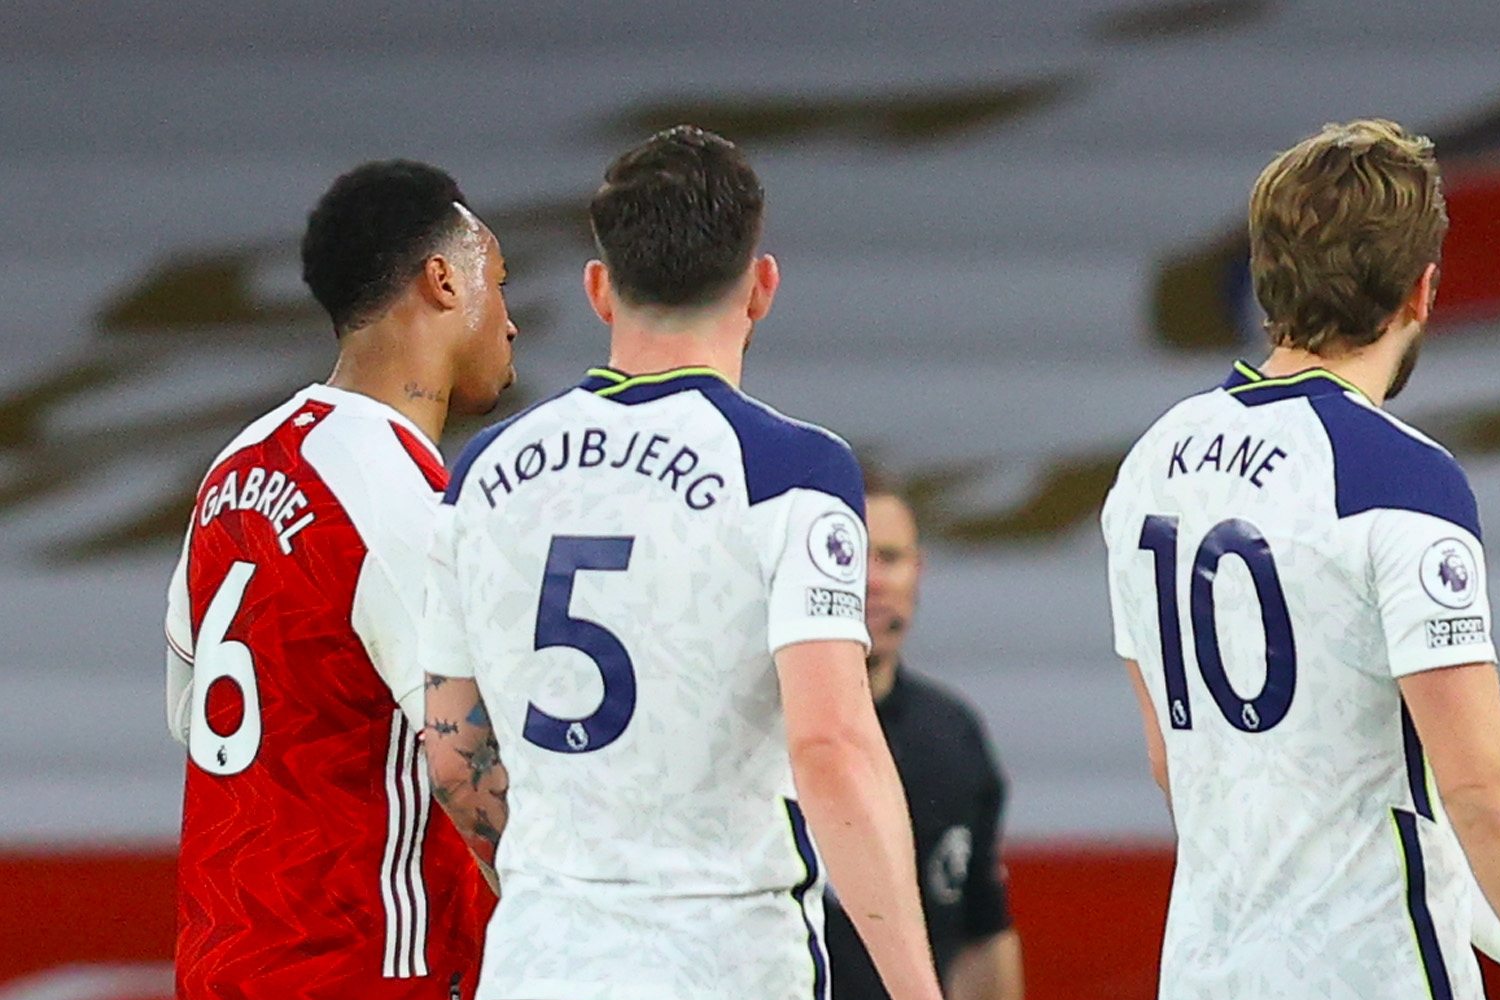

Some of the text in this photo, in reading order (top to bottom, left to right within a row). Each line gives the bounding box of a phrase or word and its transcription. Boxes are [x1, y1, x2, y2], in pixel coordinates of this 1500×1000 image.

[477, 428, 725, 511] HØJBJERG
[1168, 433, 1287, 489] KANE
[200, 466, 316, 555] GABRIEL
[188, 560, 262, 776] 6
[522, 534, 637, 754] 5
[1138, 513, 1297, 734] 10
[1427, 618, 1451, 636] No
